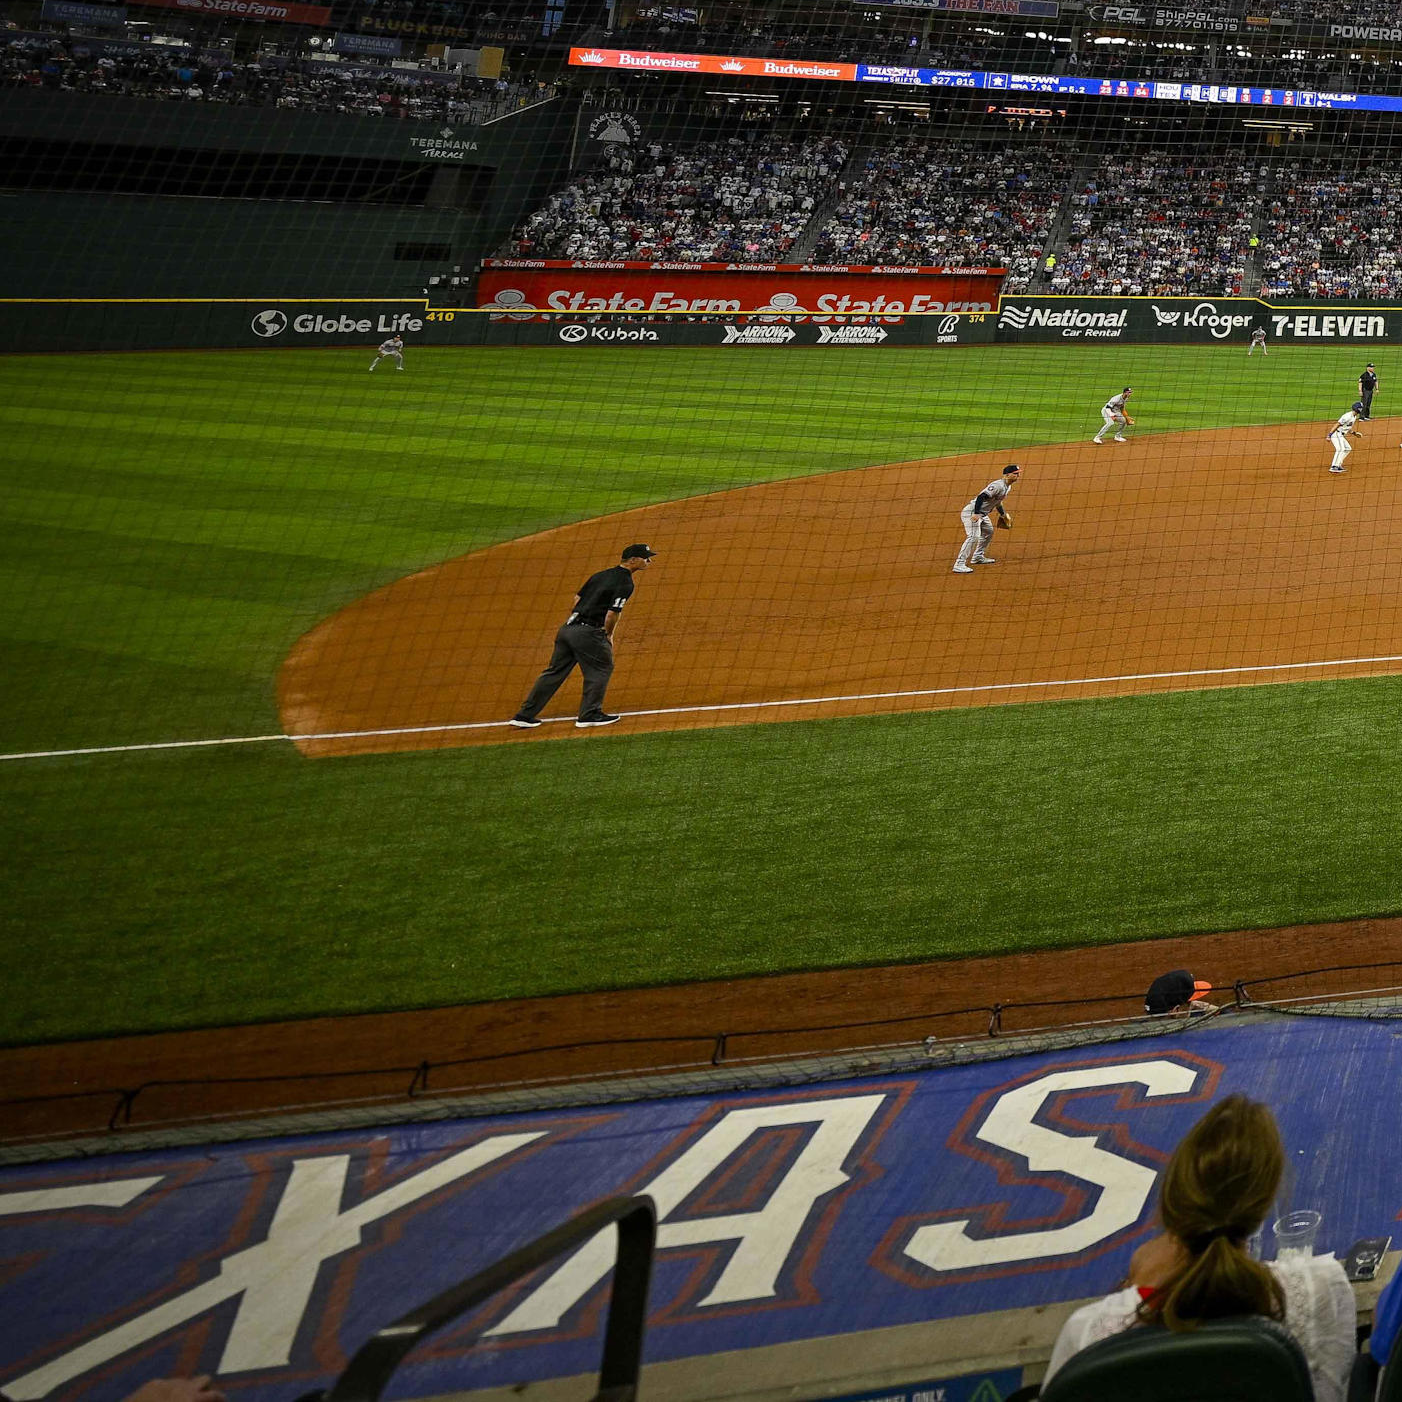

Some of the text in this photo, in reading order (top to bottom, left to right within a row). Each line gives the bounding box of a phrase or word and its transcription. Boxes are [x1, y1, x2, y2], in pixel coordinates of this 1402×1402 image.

[1103, 6, 1146, 22] PGL
[1156, 10, 1239, 25] ShipPGL.com
[360, 16, 469, 39] PLUCKERS
[618, 53, 701, 70] Budweiser
[764, 61, 841, 78] Budweiser
[1010, 74, 1061, 85] BROWN
[1316, 92, 1357, 103] WALSH
[410, 137, 479, 152] TEREMANA
[541, 290, 646, 318] State
[812, 293, 905, 319] State
[293, 313, 423, 334] Globe Life
[425, 312, 455, 322] 410
[969, 314, 985, 323] 374
[1184, 302, 1252, 339] Kroger
[592, 326, 657, 341] Kubota
[740, 325, 785, 337] ARROW
[833, 325, 877, 337] ARROW
[1062, 328, 1121, 337] Car Rental
[936, 335, 958, 343] SPORTS
